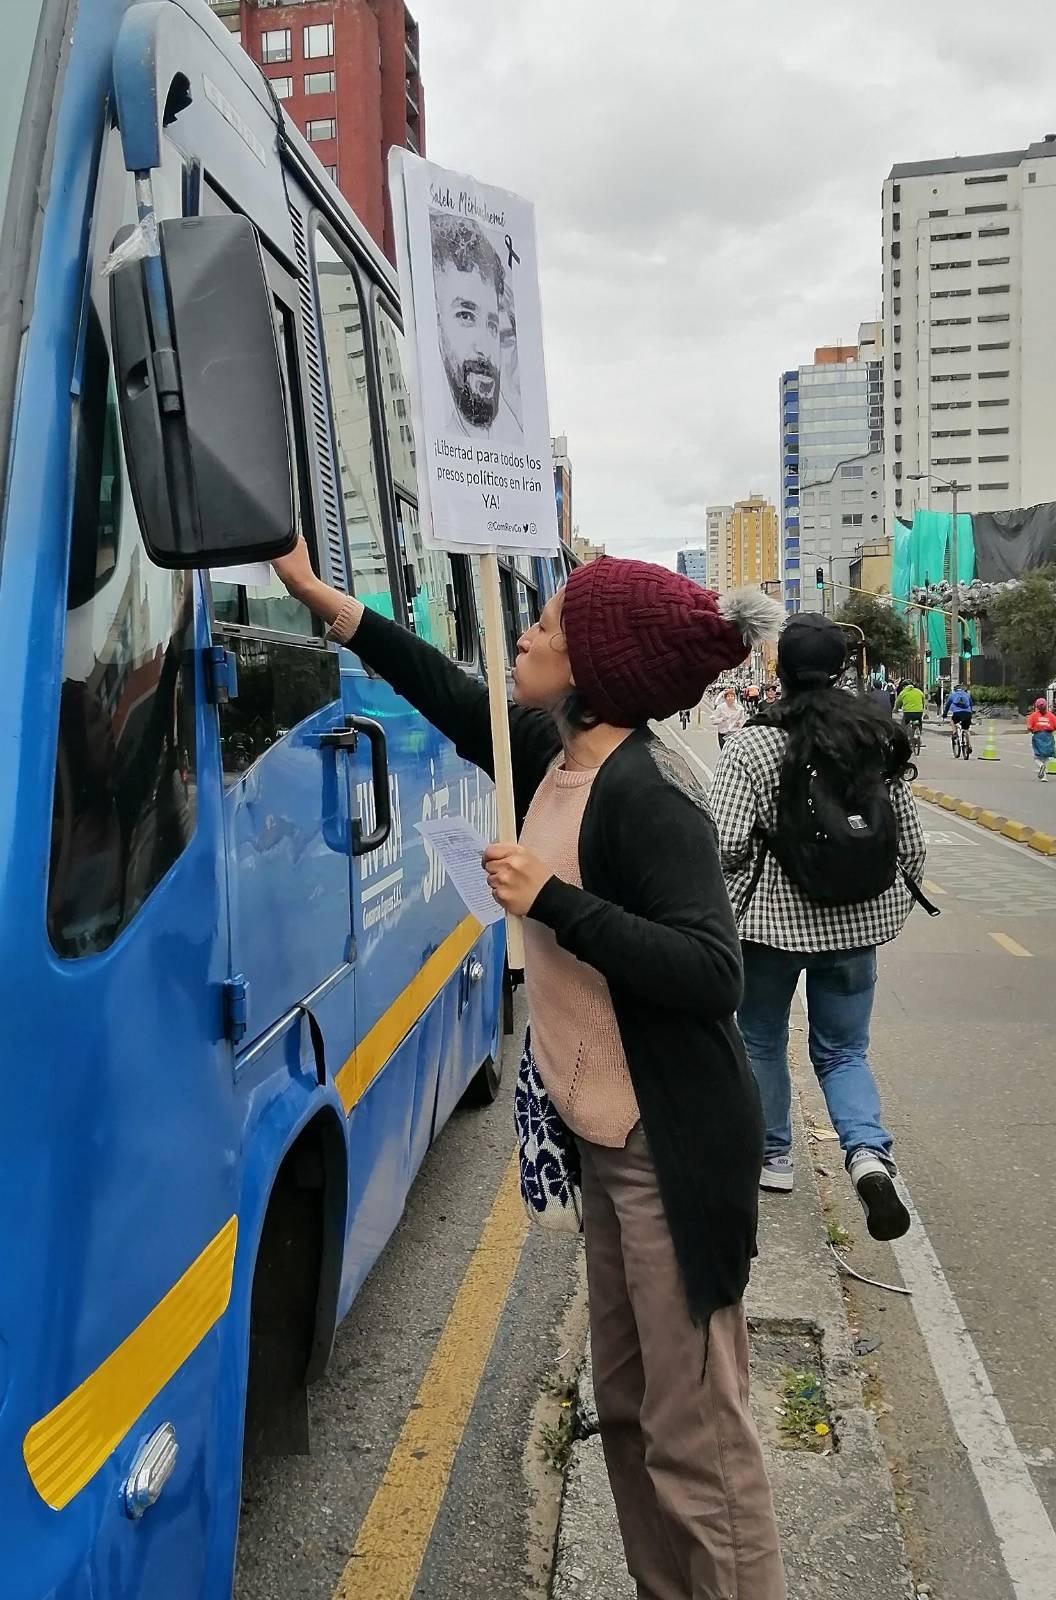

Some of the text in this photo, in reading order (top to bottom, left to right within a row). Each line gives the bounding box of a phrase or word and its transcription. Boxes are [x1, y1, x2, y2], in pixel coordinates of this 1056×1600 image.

[429, 183, 455, 210] Saleh
[434, 438, 542, 470] ¡Libertad para todos los
[437, 467, 542, 492] presos políticos en Irán
[481, 493, 500, 510] YA!
